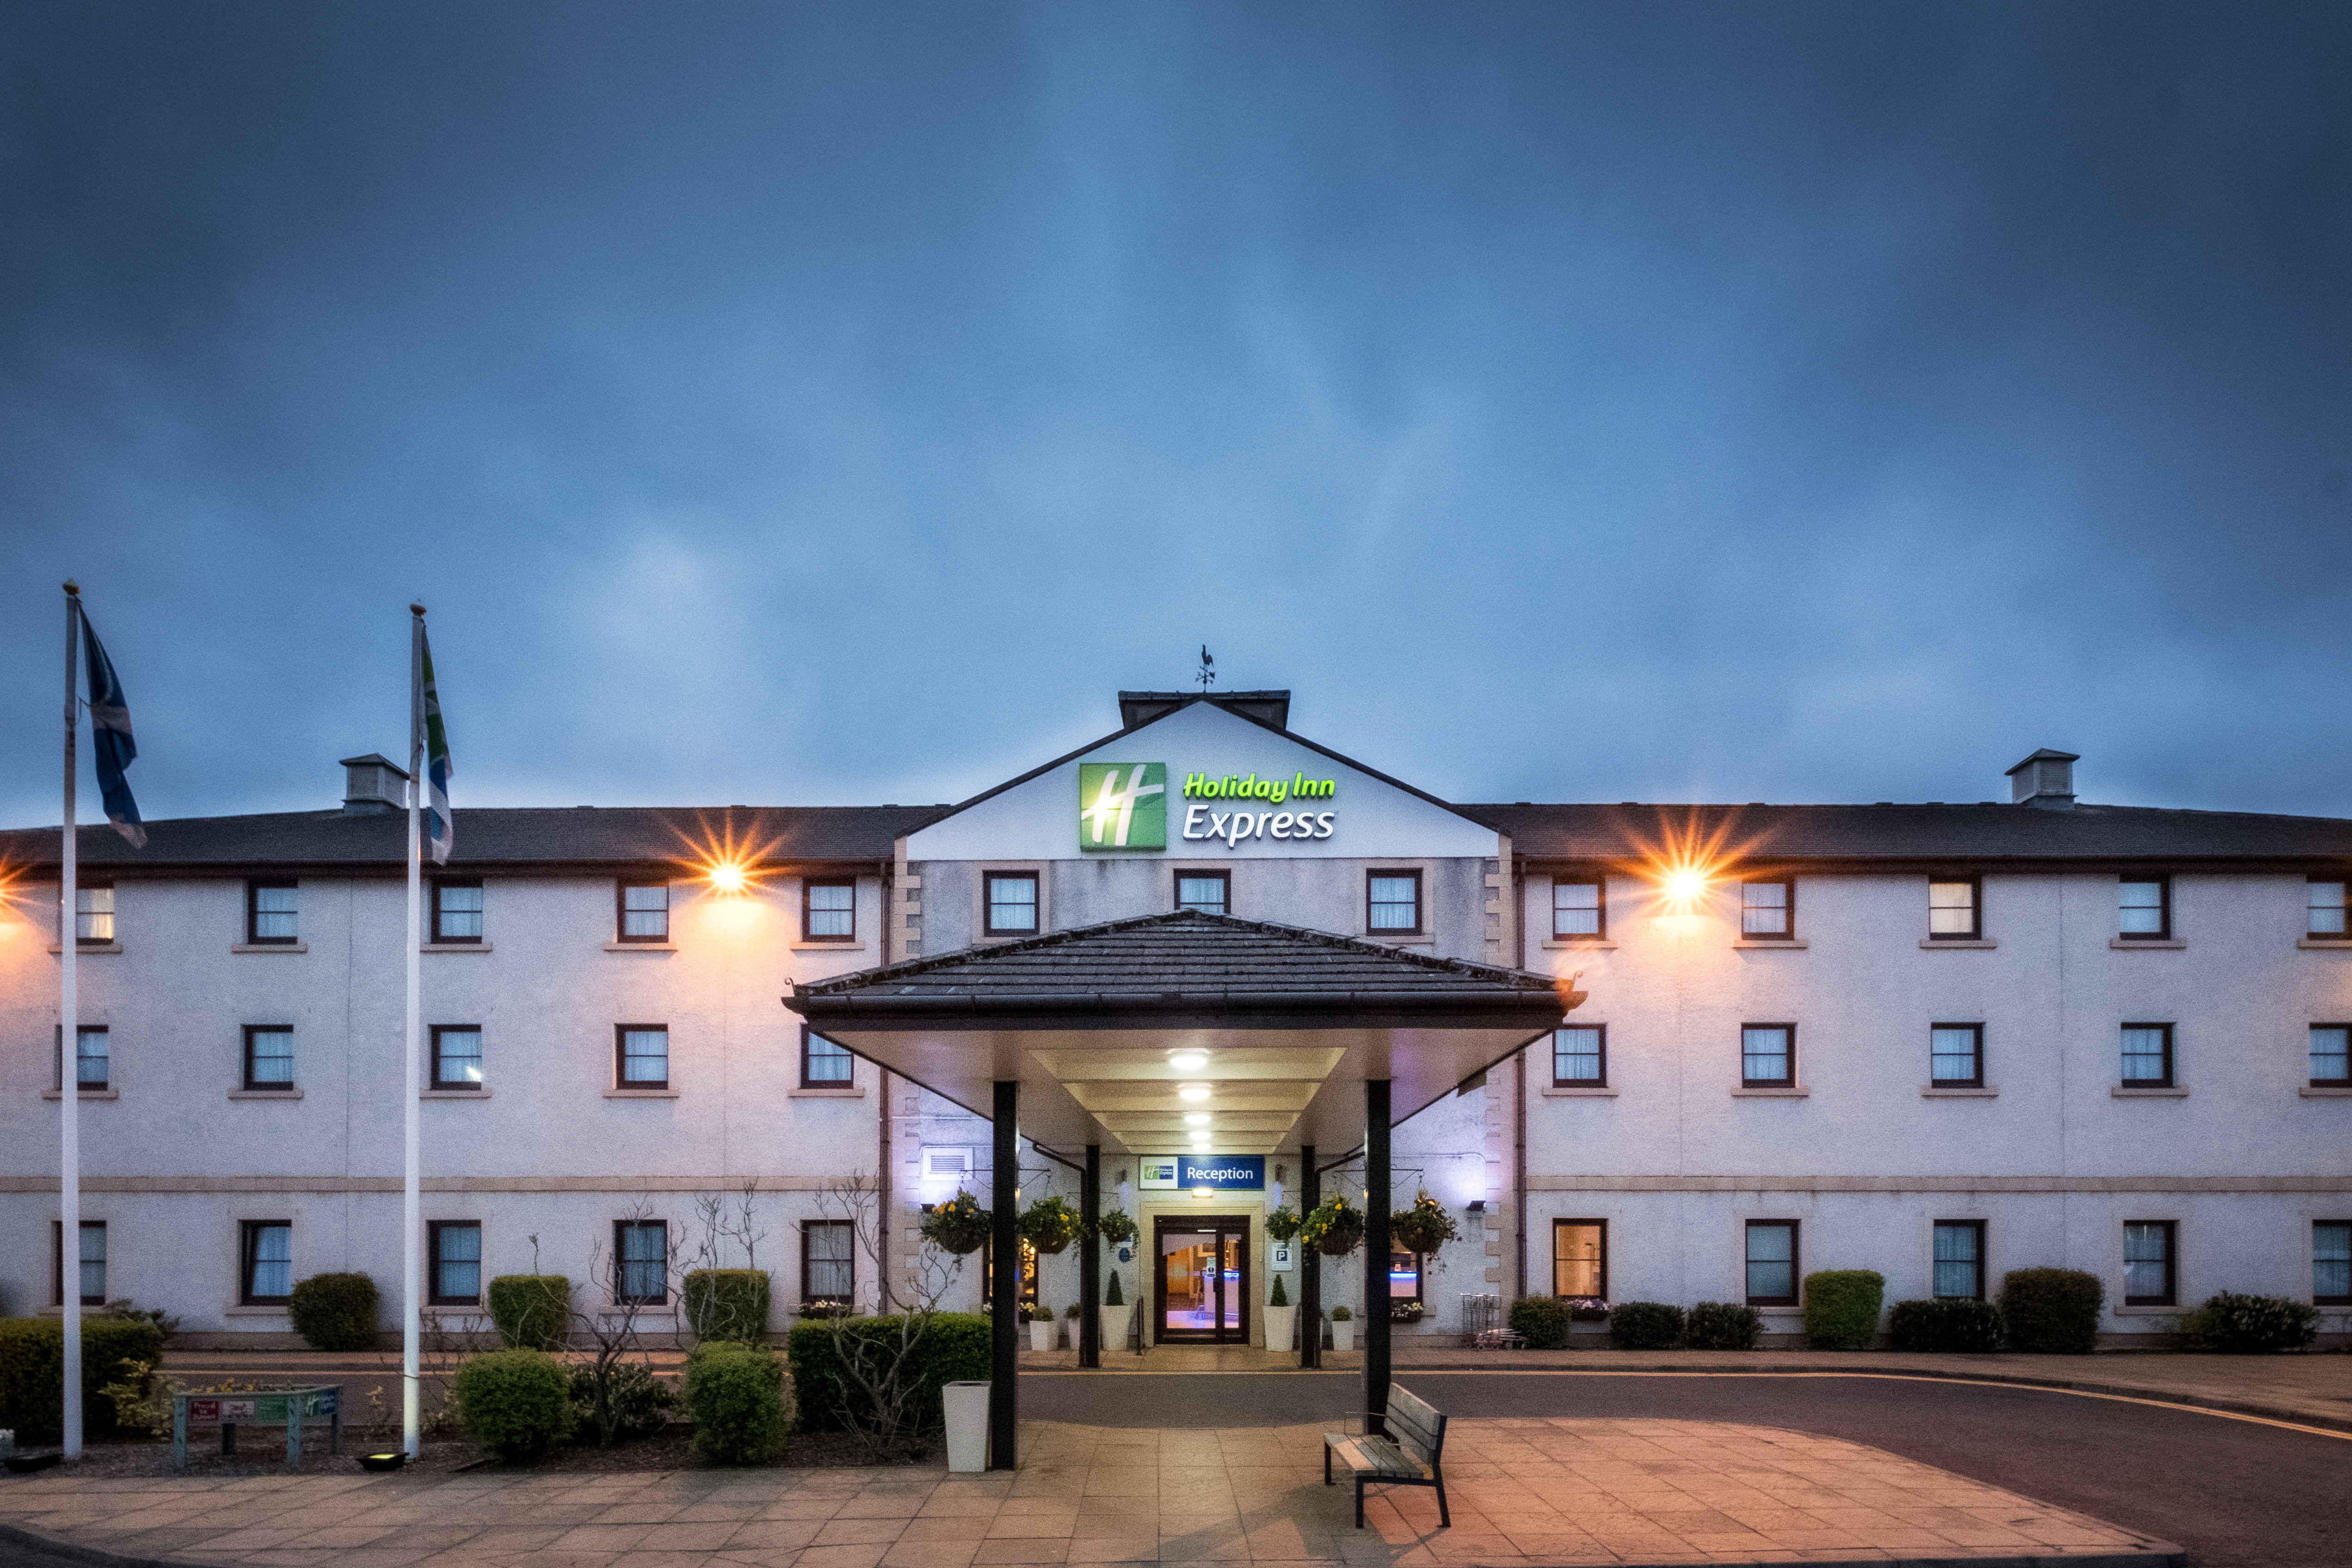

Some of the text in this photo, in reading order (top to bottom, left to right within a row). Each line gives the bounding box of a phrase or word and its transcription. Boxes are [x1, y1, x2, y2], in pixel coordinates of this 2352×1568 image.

[1183, 771, 1335, 803] Holiday Inn
[1183, 804, 1335, 848] Express
[1187, 1167, 1254, 1182] Reception
[1278, 1251, 1286, 1260] P
